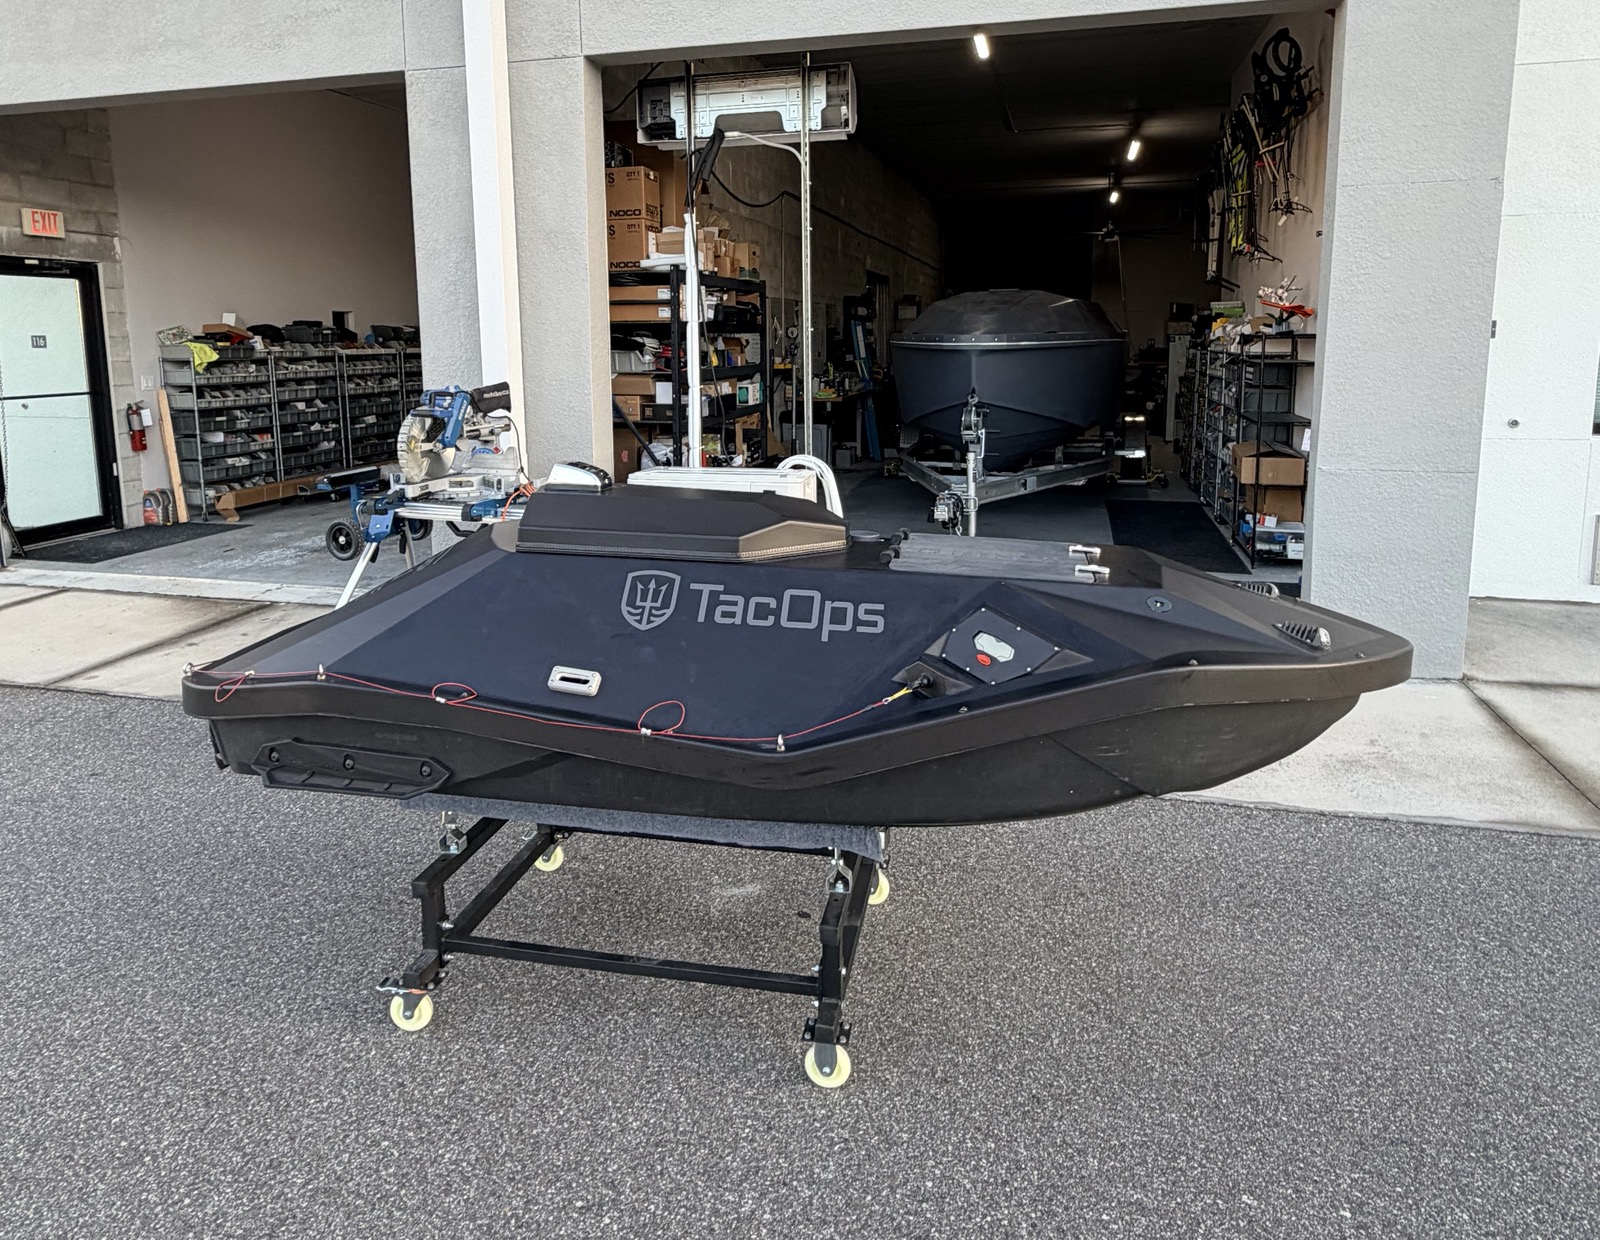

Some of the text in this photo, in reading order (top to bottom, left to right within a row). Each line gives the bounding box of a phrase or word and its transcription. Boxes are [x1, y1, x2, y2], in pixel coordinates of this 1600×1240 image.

[606, 172, 615, 184] S
[609, 208, 642, 217] NOCO
[31, 210, 58, 235] EXIT
[608, 224, 616, 236] S
[610, 260, 640, 269] NOCO
[32, 337, 45, 346] 116
[689, 582, 885, 642] TacOps
